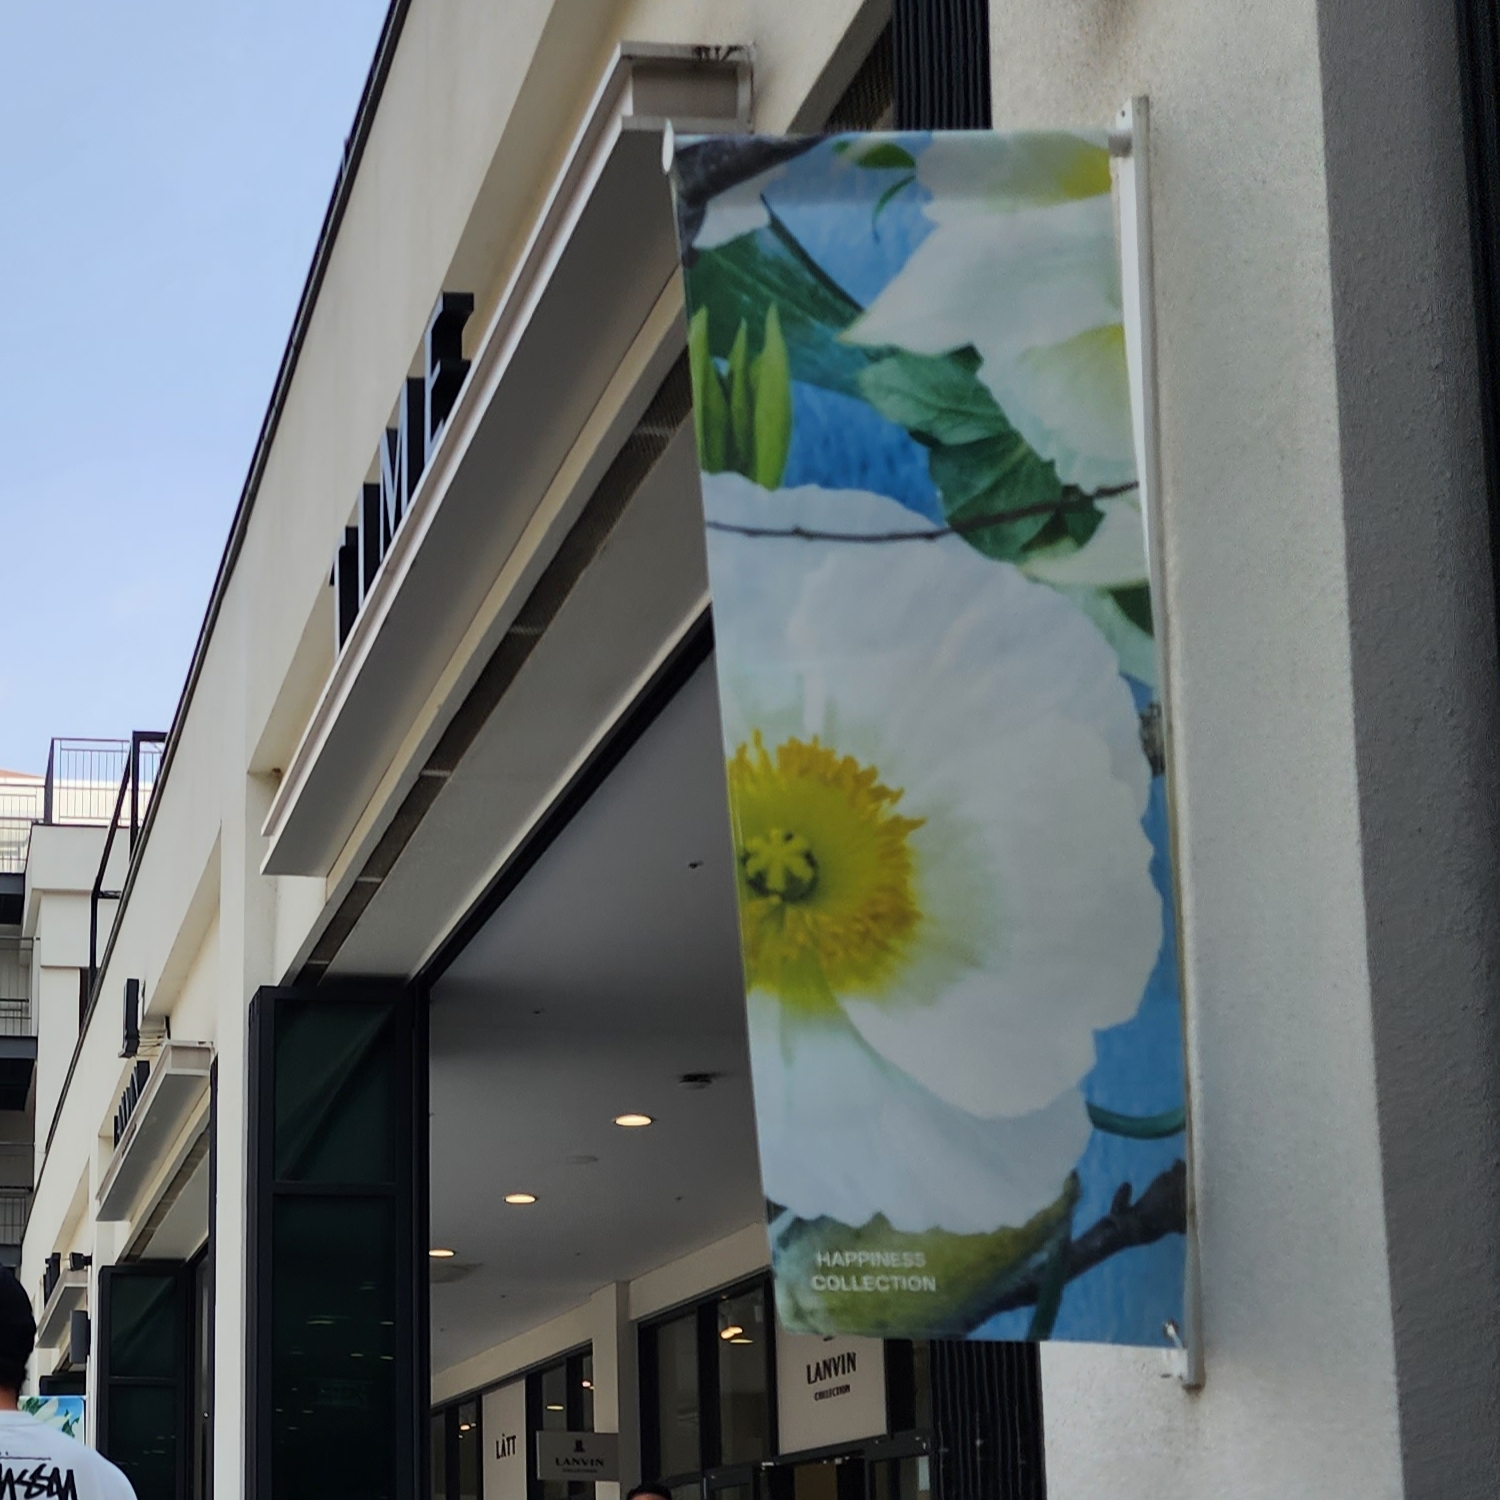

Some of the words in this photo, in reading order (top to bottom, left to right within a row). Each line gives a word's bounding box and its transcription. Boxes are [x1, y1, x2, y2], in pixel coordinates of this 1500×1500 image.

[816, 1250, 926, 1268] HAPPINESS
[811, 1274, 937, 1292] COLLECTION
[806, 1351, 857, 1385] LANVIN
[555, 1457, 604, 1467] LANVIN
